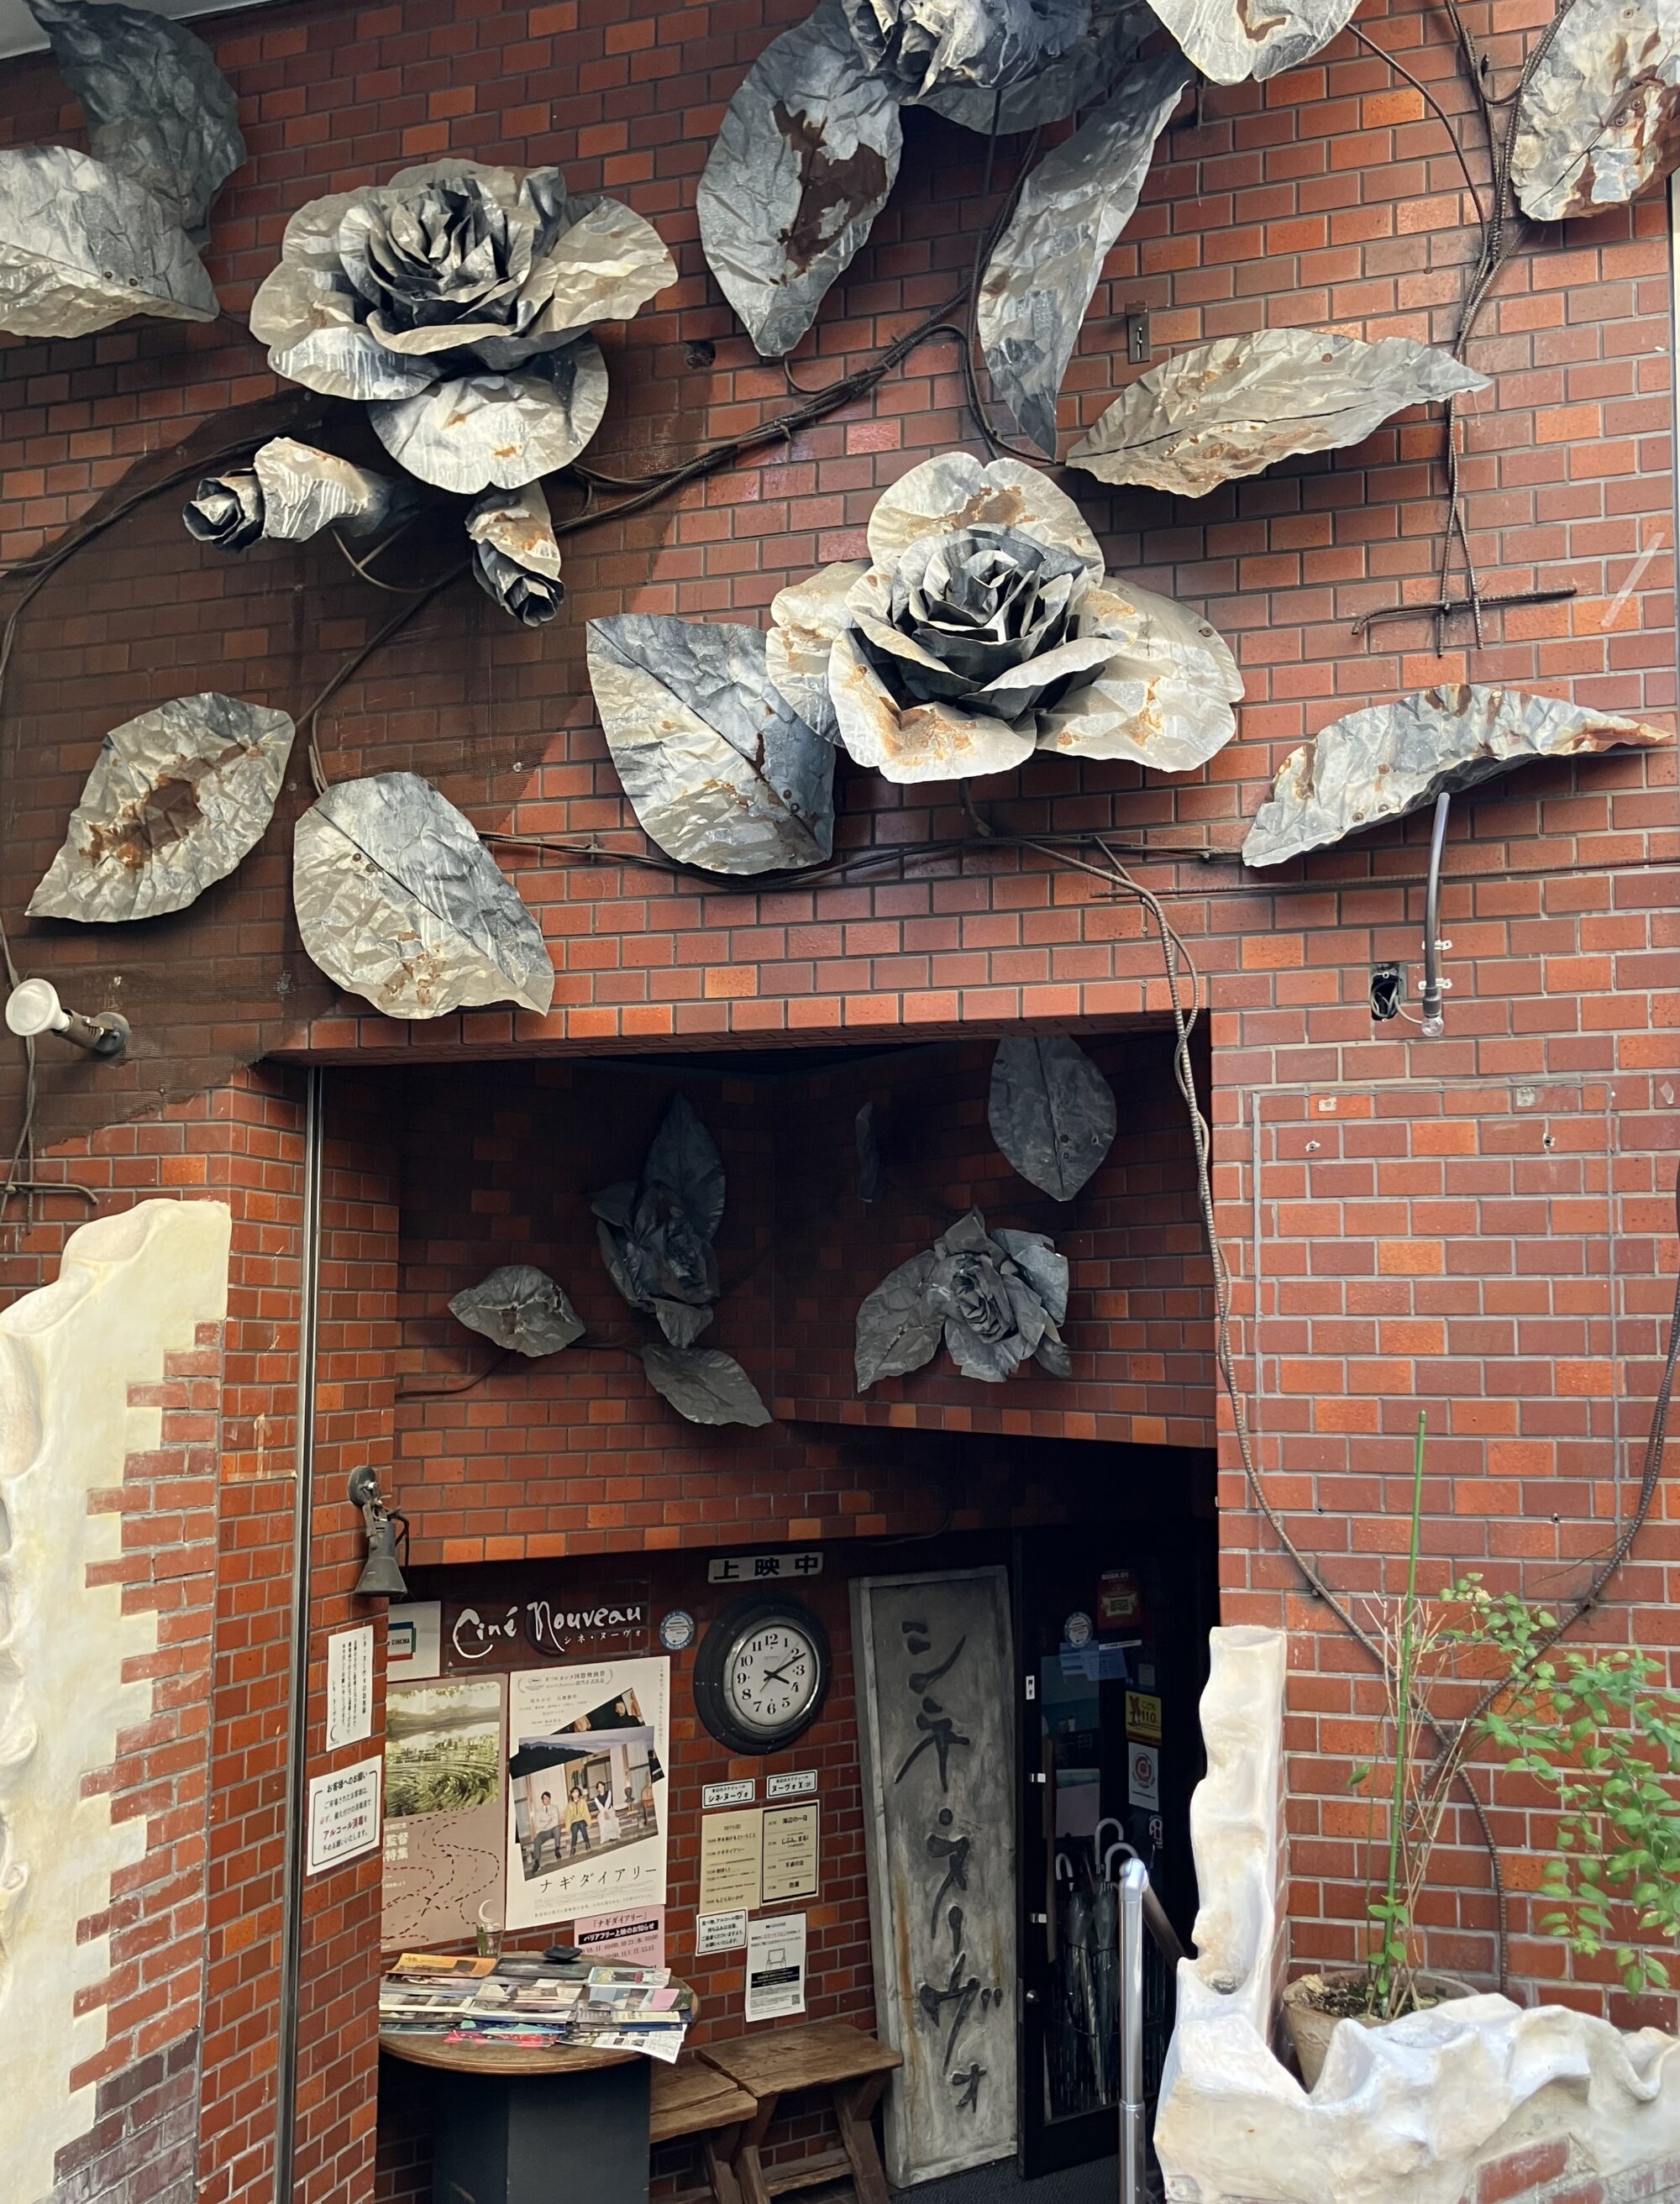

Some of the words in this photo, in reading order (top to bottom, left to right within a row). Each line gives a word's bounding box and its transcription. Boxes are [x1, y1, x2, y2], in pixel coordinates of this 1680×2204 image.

[713, 1555, 818, 1580] 上映中
[453, 1606, 518, 1658] Ciné
[527, 1601, 641, 1651] Nouveau
[752, 1641, 762, 1651] 11
[764, 1634, 779, 1646] 12
[784, 1637, 789, 1648] 1
[791, 1648, 800, 1659] 2
[740, 1655, 753, 1667] 10
[795, 1665, 805, 1676] 3
[738, 1672, 747, 1684] 9
[791, 1682, 799, 1692] 4
[742, 1688, 752, 1700] 8
[753, 1701, 762, 1713] 7
[767, 1703, 776, 1715] 6
[781, 1698, 790, 1708] 5
[1141, 1710, 1156, 1722] 110
[327, 1771, 368, 1793] お客様へのお願い
[385, 1847, 408, 1862] 特集
[540, 1866, 657, 1894] ナギダイアリー
[584, 1923, 654, 1941] バリアフリー上映のお知らせ
